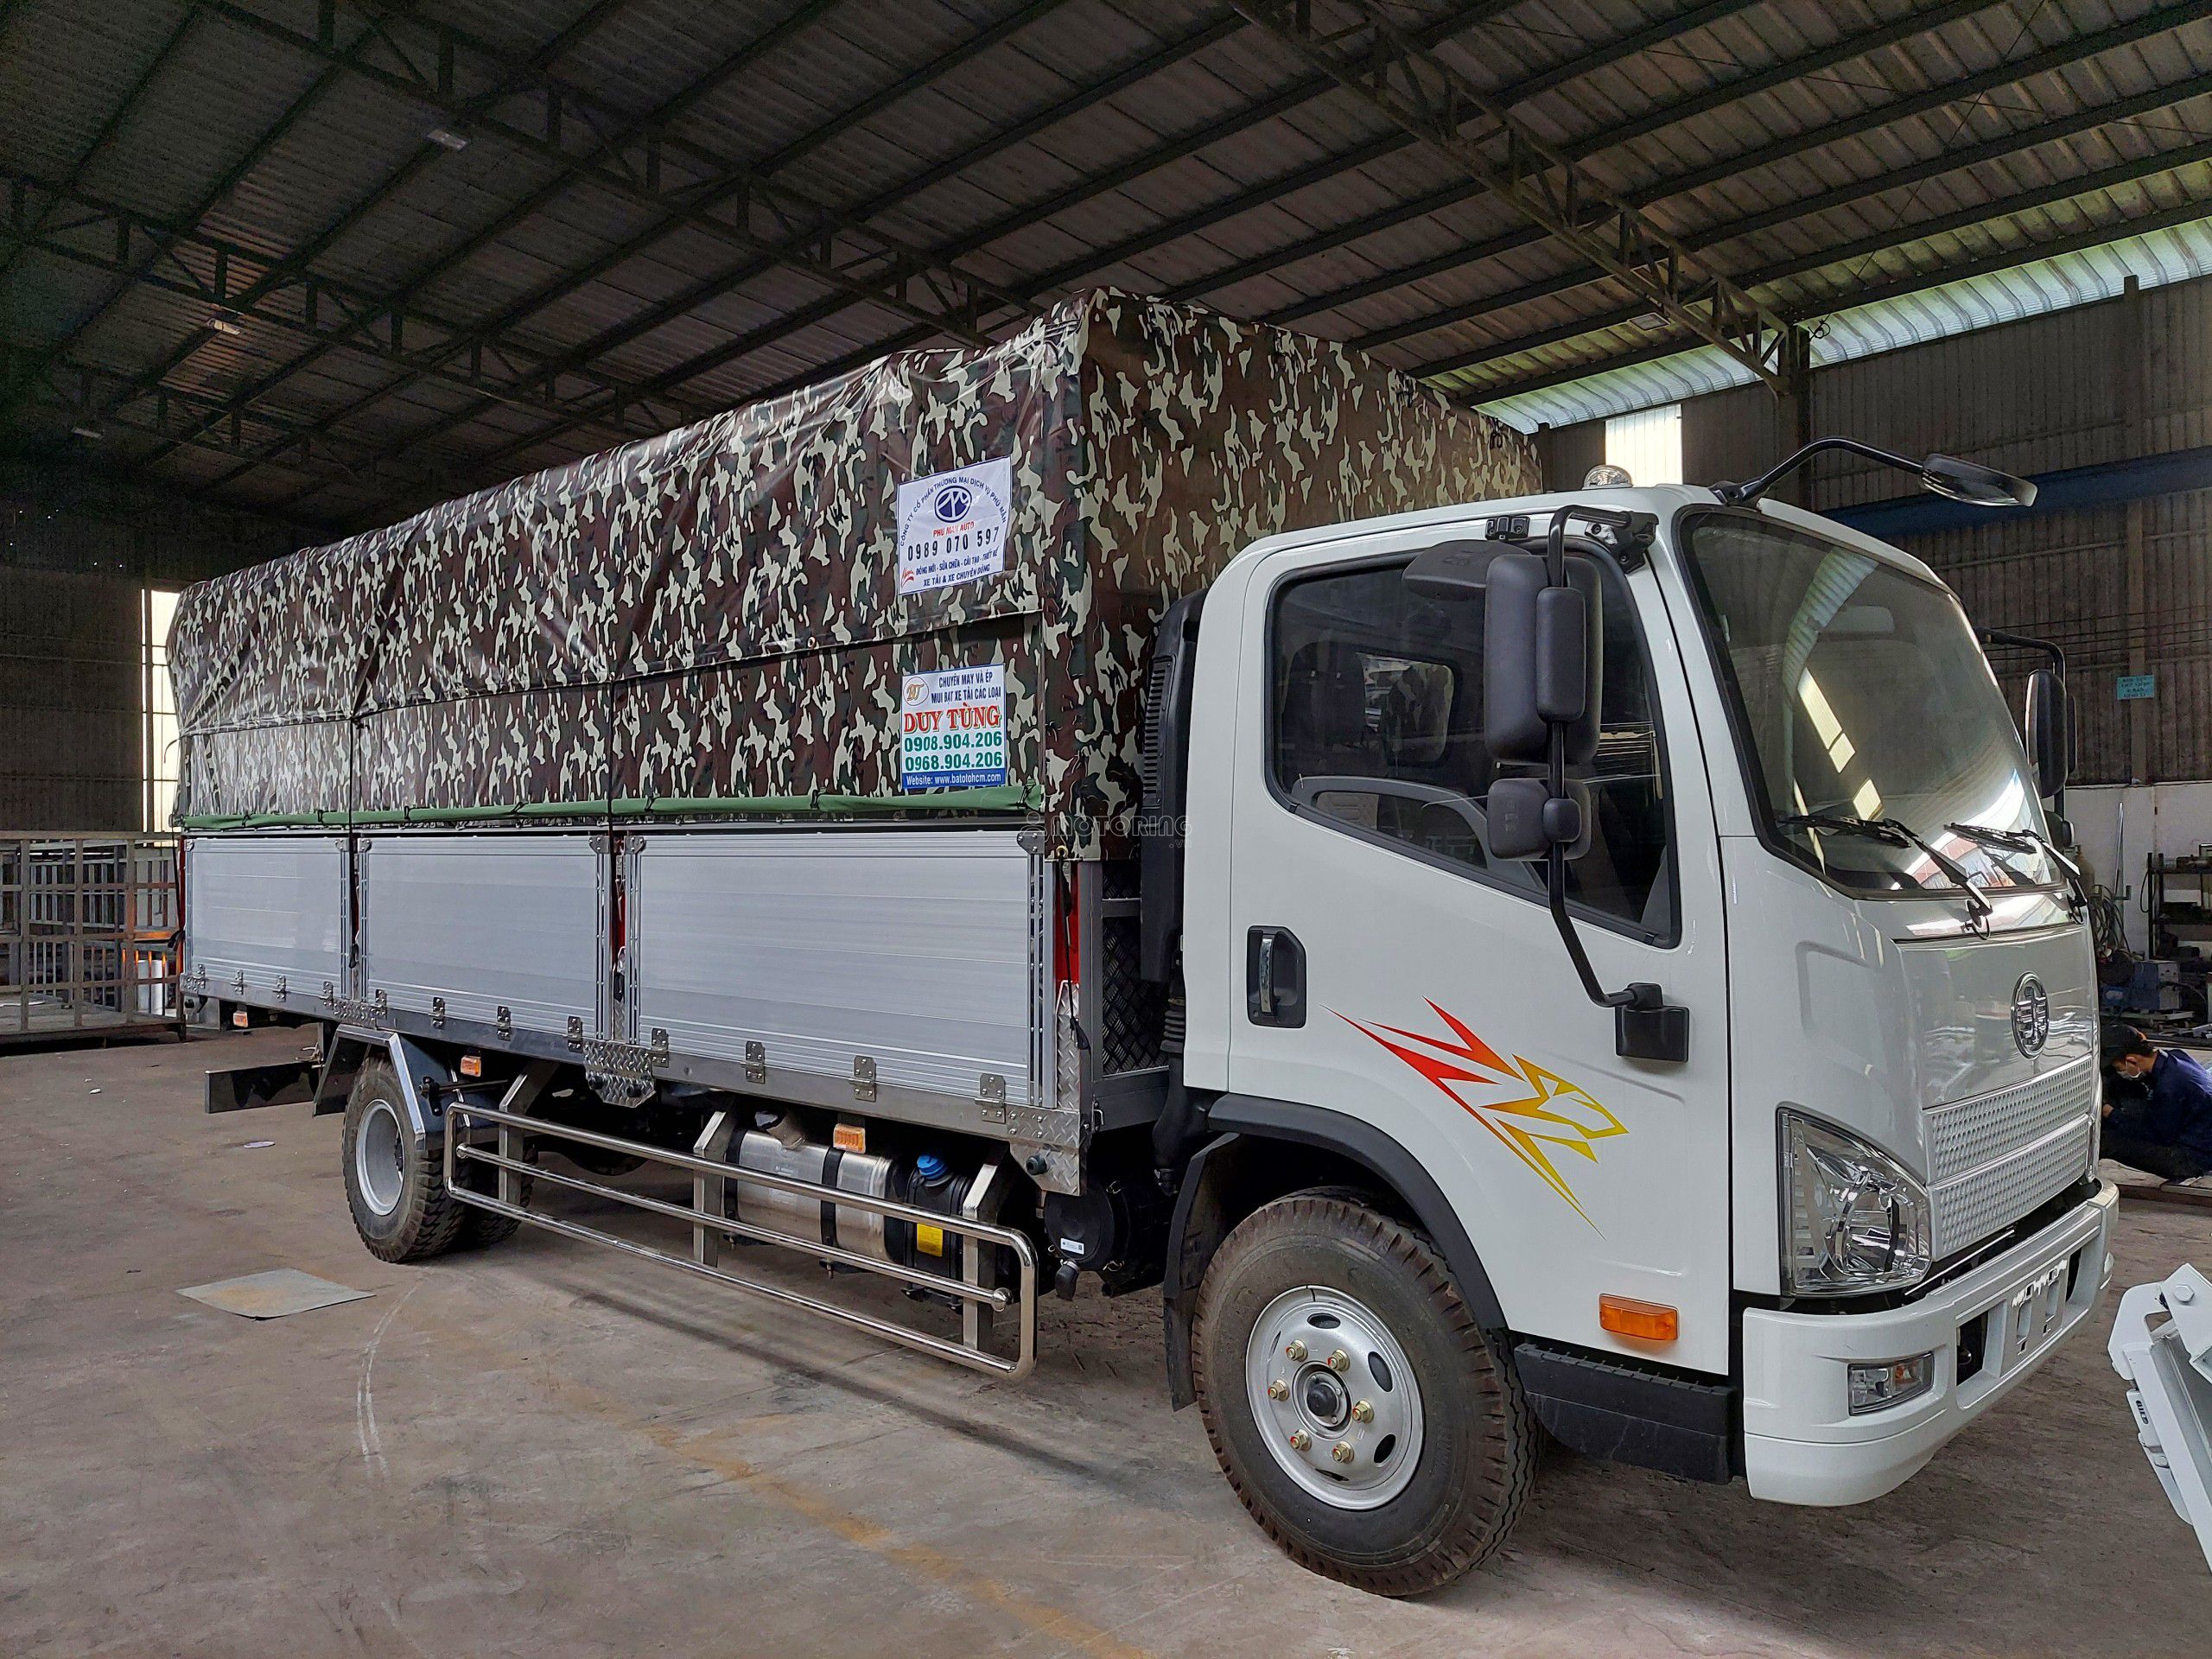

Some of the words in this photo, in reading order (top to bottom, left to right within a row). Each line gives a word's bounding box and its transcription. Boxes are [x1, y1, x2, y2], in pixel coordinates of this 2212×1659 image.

[907, 512, 914, 522] TY
[969, 478, 984, 489] DỊCH
[990, 493, 1001, 506] PHÚ
[959, 522, 975, 531] AUTO
[907, 541, 938, 562] 0989
[947, 534, 968, 553] 070
[977, 526, 999, 547] 597
[947, 574, 955, 582] XE
[961, 673, 976, 685] MAY
[976, 671, 983, 683] VÀ
[985, 669, 993, 683] ÉP
[931, 693, 944, 703] MUI
[944, 691, 954, 705] BẠT
[955, 690, 963, 702] XE
[975, 685, 987, 700] CÁC
[988, 686, 1001, 700] LOẠI
[904, 711, 944, 734] DUY
[947, 702, 1001, 731] TÙNG
[904, 731, 1002, 752] 0908.904.206
[906, 752, 1002, 771] 0968.904.206
[906, 774, 933, 785] Website:
[935, 772, 1001, 785] www.batotohcm.com
